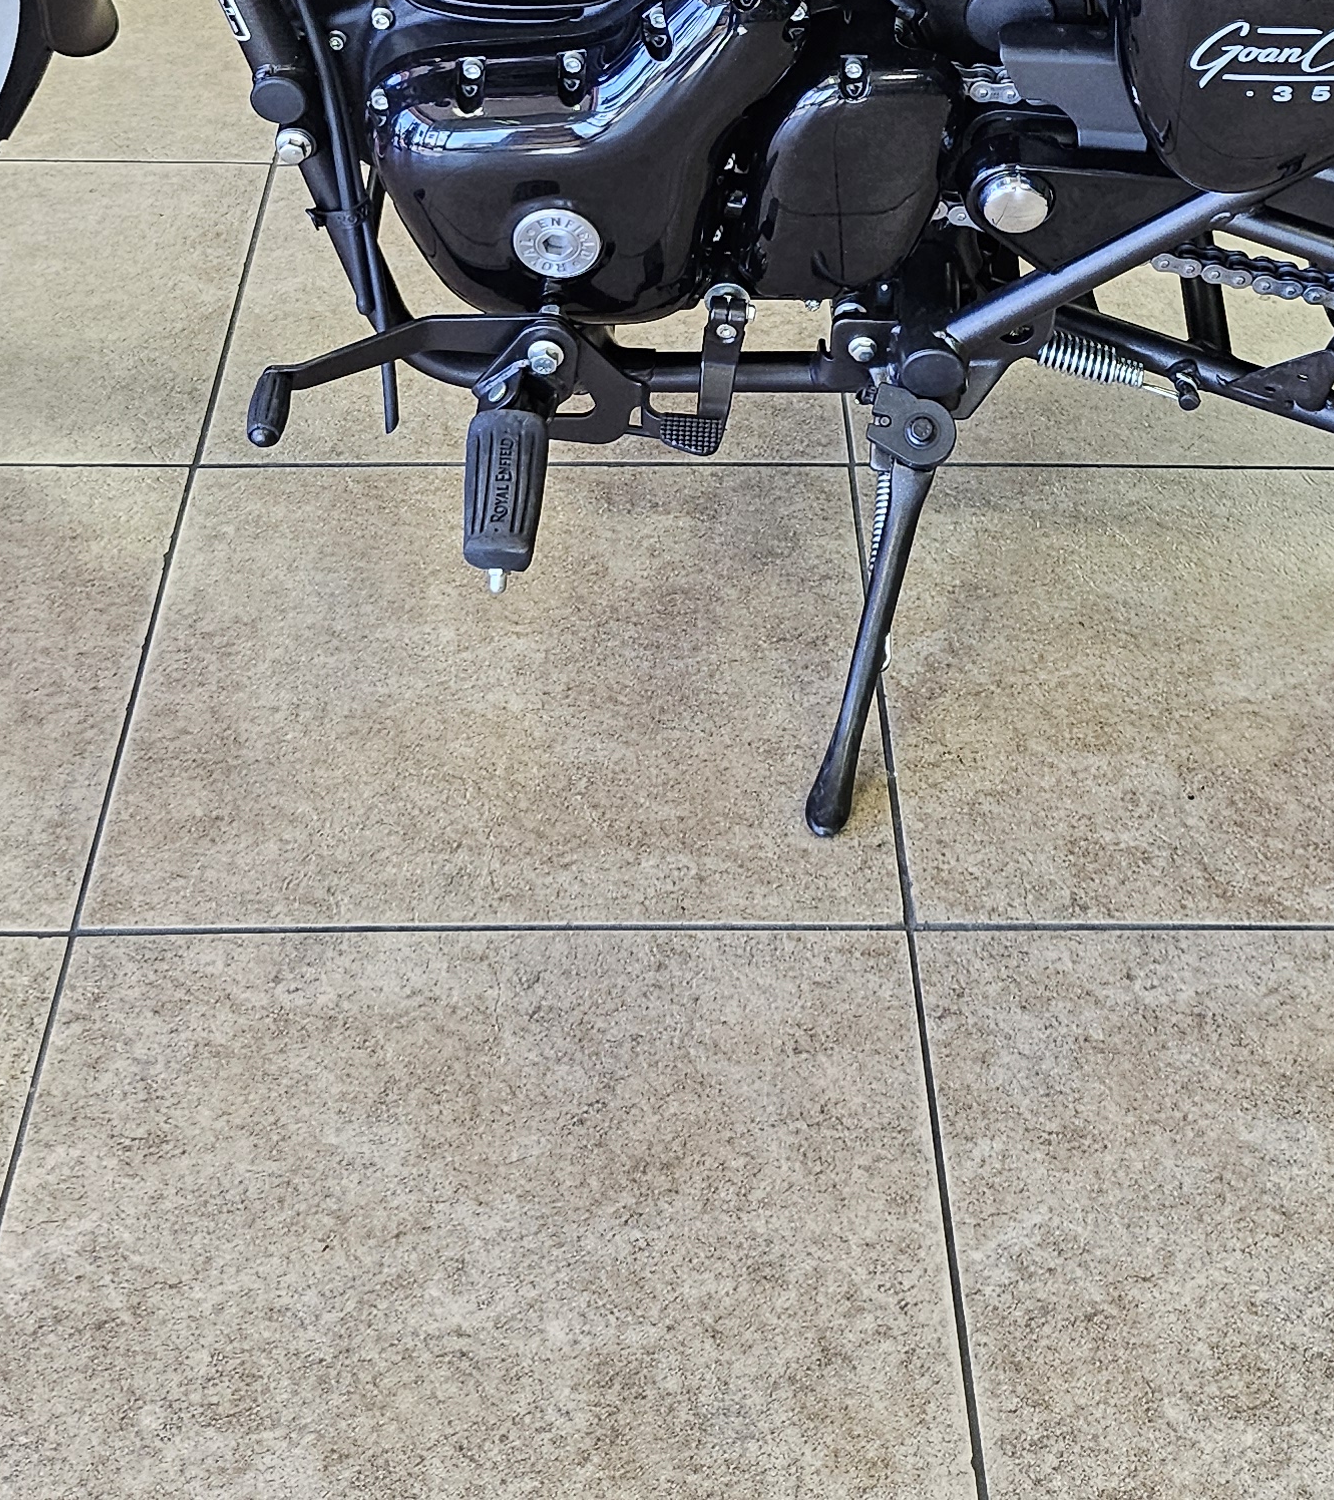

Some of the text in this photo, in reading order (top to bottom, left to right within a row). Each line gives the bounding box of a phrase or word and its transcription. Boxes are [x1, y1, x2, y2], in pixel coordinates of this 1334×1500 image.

[1189, 19, 1306, 89] Goan
[519, 238, 567, 273] ROYAL
[536, 217, 596, 261] ENFIELD
[489, 437, 515, 524] ROYAL ENFIELD
